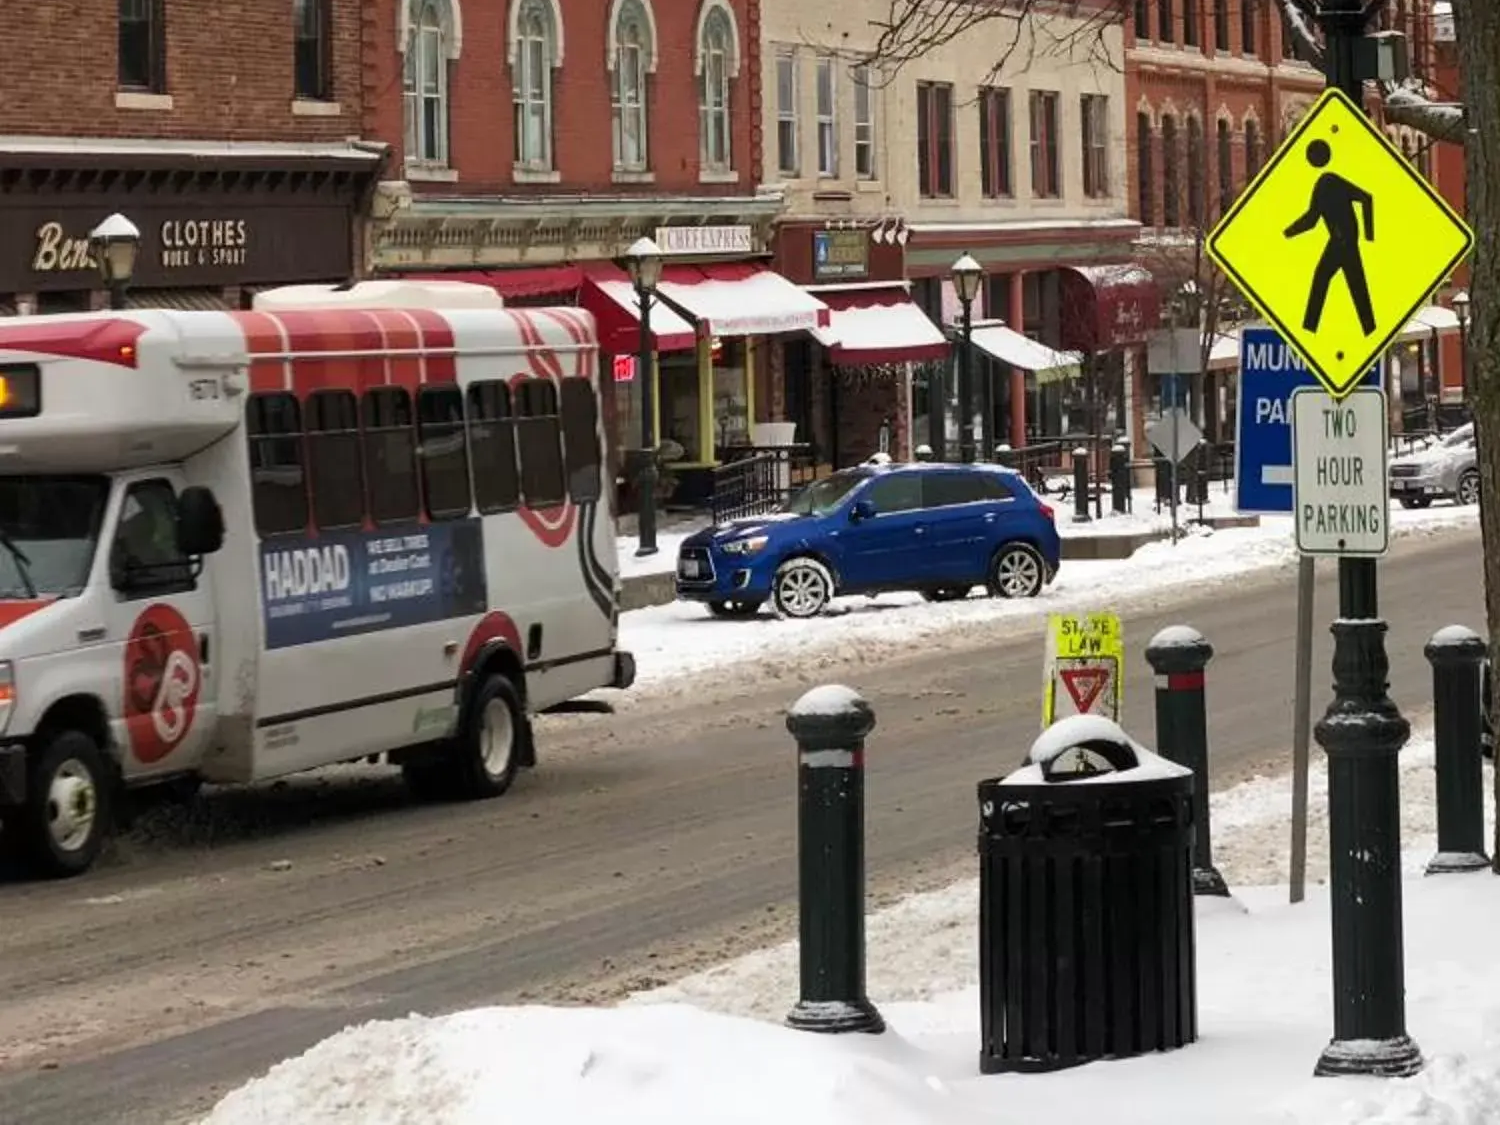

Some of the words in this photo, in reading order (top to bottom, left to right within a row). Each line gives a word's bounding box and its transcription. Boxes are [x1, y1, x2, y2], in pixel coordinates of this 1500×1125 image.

[162, 220, 246, 246] CLOTHES
[213, 249, 246, 265] SPORT
[1322, 410, 1357, 439] TWO
[1317, 456, 1364, 486] HOUR
[1304, 504, 1380, 534] PARKING
[264, 544, 350, 600] HADDAD
[1062, 618, 1110, 636] STTE
[1069, 636, 1101, 653] LAW
